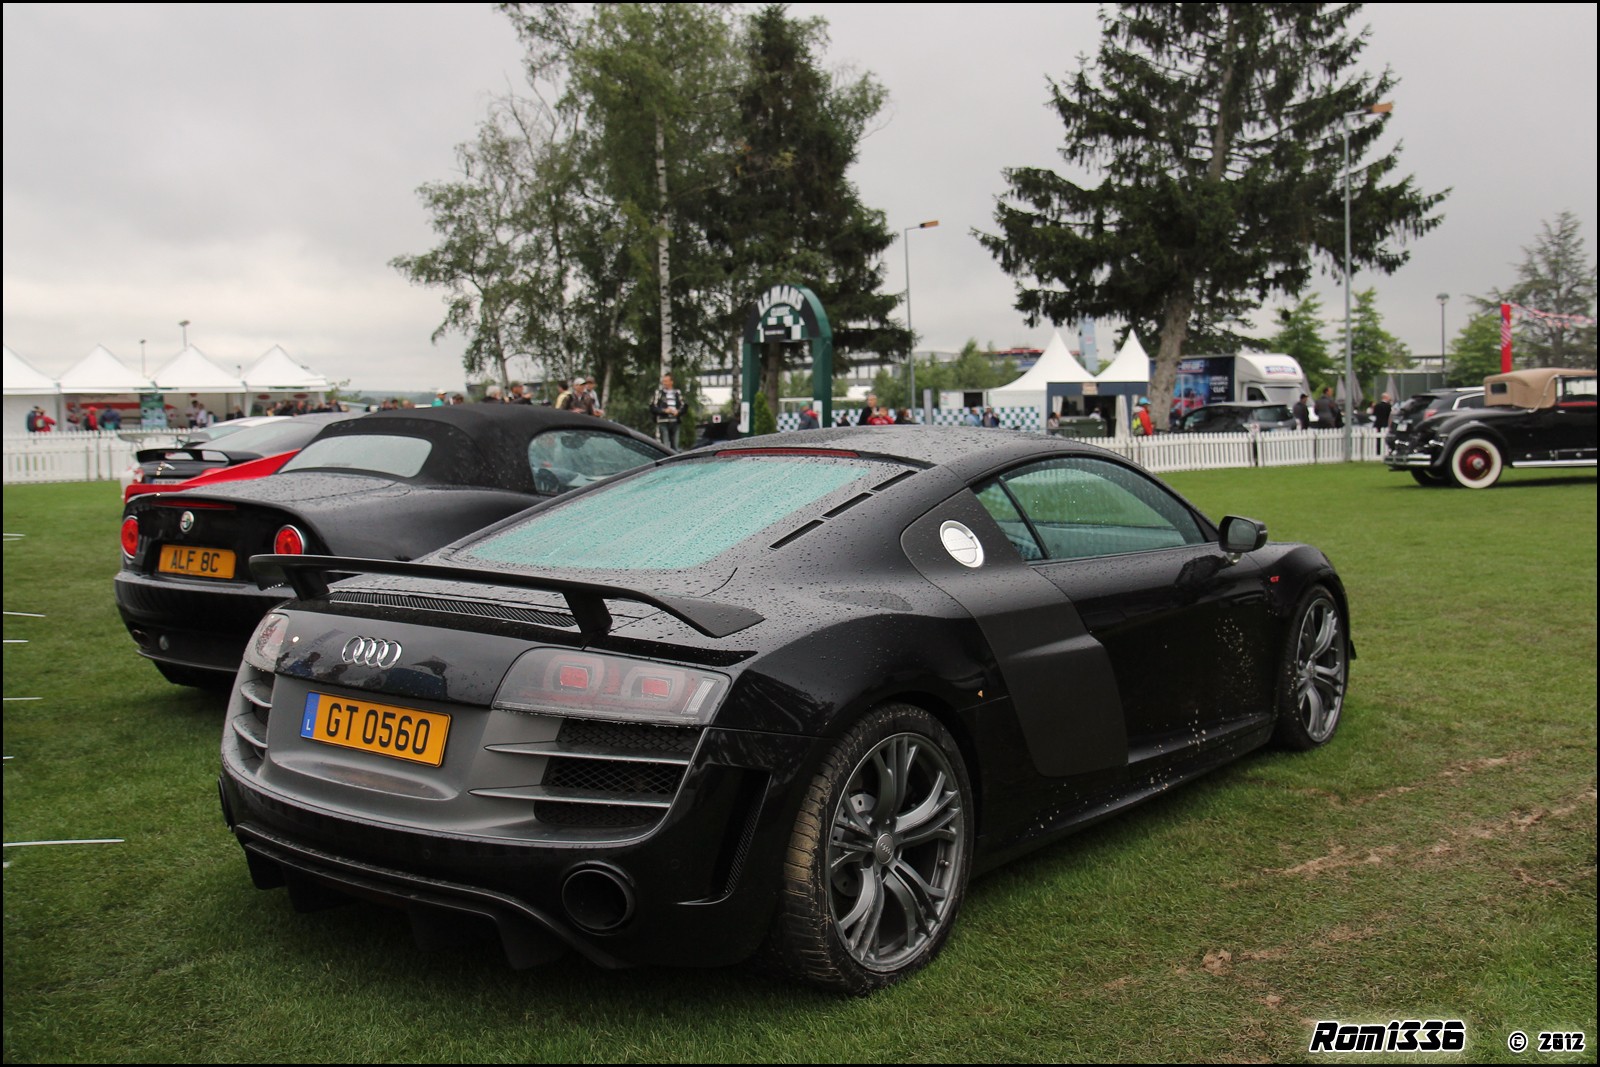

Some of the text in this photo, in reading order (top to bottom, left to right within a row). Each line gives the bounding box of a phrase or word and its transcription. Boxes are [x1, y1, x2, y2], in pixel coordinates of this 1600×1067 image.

[171, 550, 220, 573] ALF 8C
[305, 719, 311, 731] L
[326, 703, 431, 755] GT 0560
